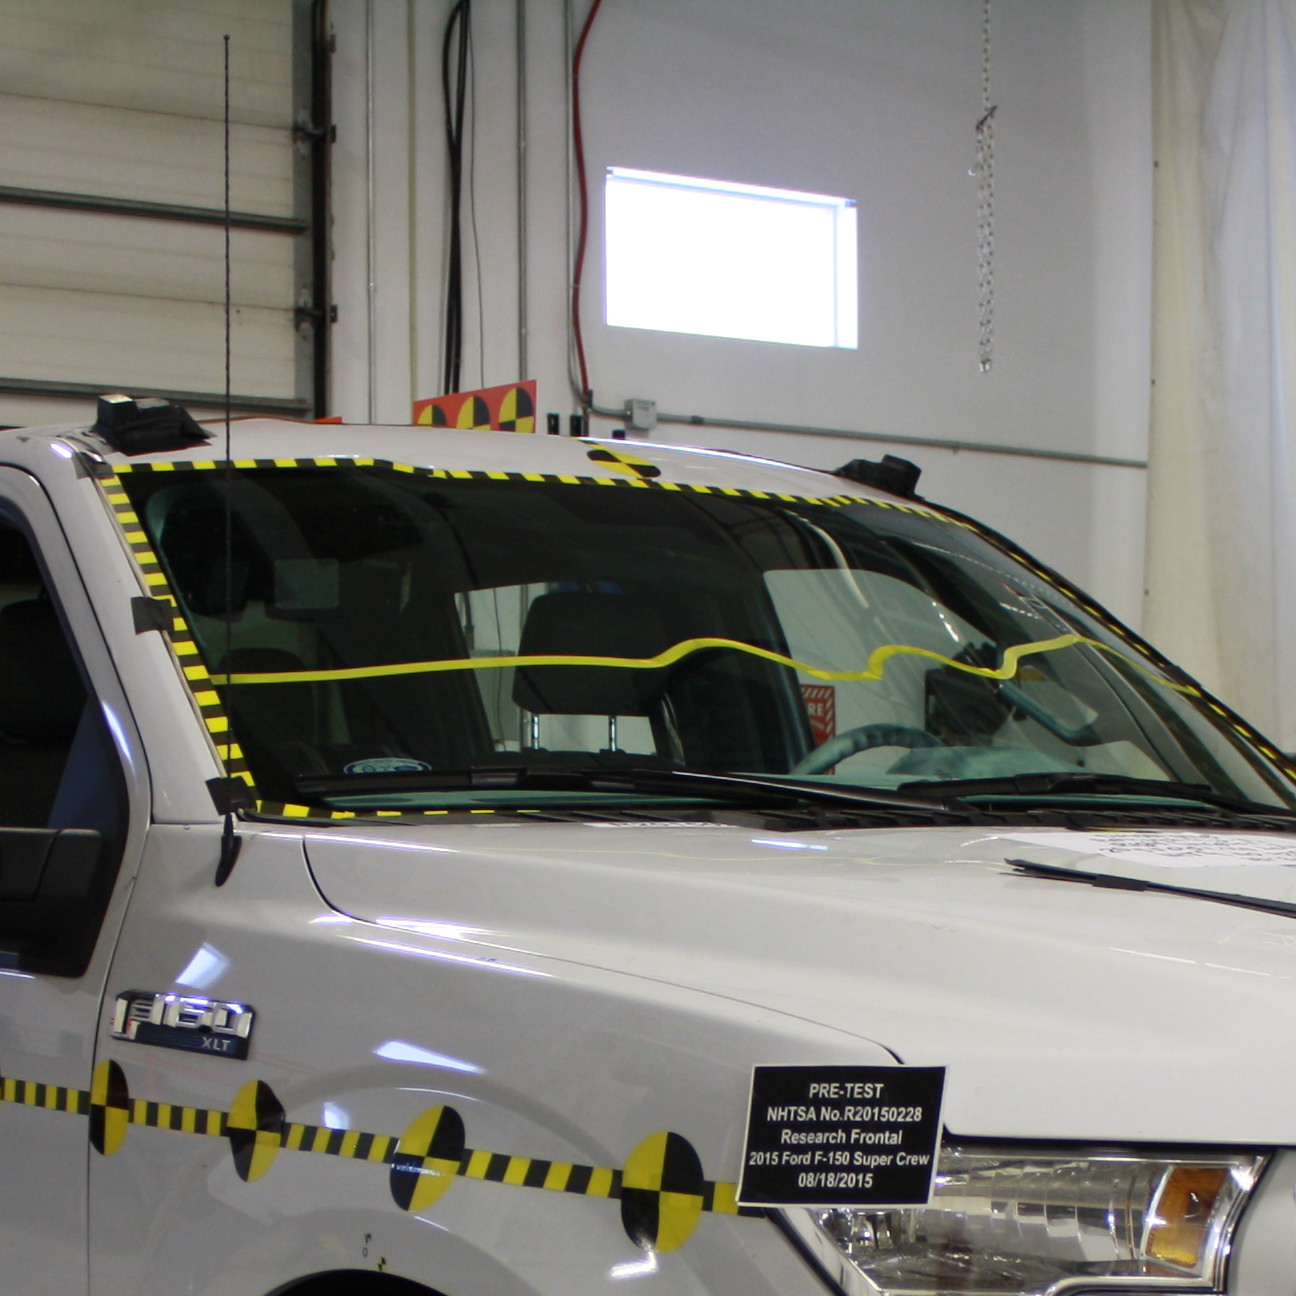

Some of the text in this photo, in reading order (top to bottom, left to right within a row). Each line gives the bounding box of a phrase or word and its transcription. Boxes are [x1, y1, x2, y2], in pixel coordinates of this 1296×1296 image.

[808, 703, 824, 716] RE
[202, 1036, 231, 1051] XLT
[809, 1083, 884, 1098] PRE-TEST
[767, 1107, 816, 1122] NHTSA
[781, 1129, 902, 1144] Research Frontal
[749, 1152, 930, 1168] 2015 Ford F-150 Super Crew
[798, 1172, 873, 1188] 08/18/2015
